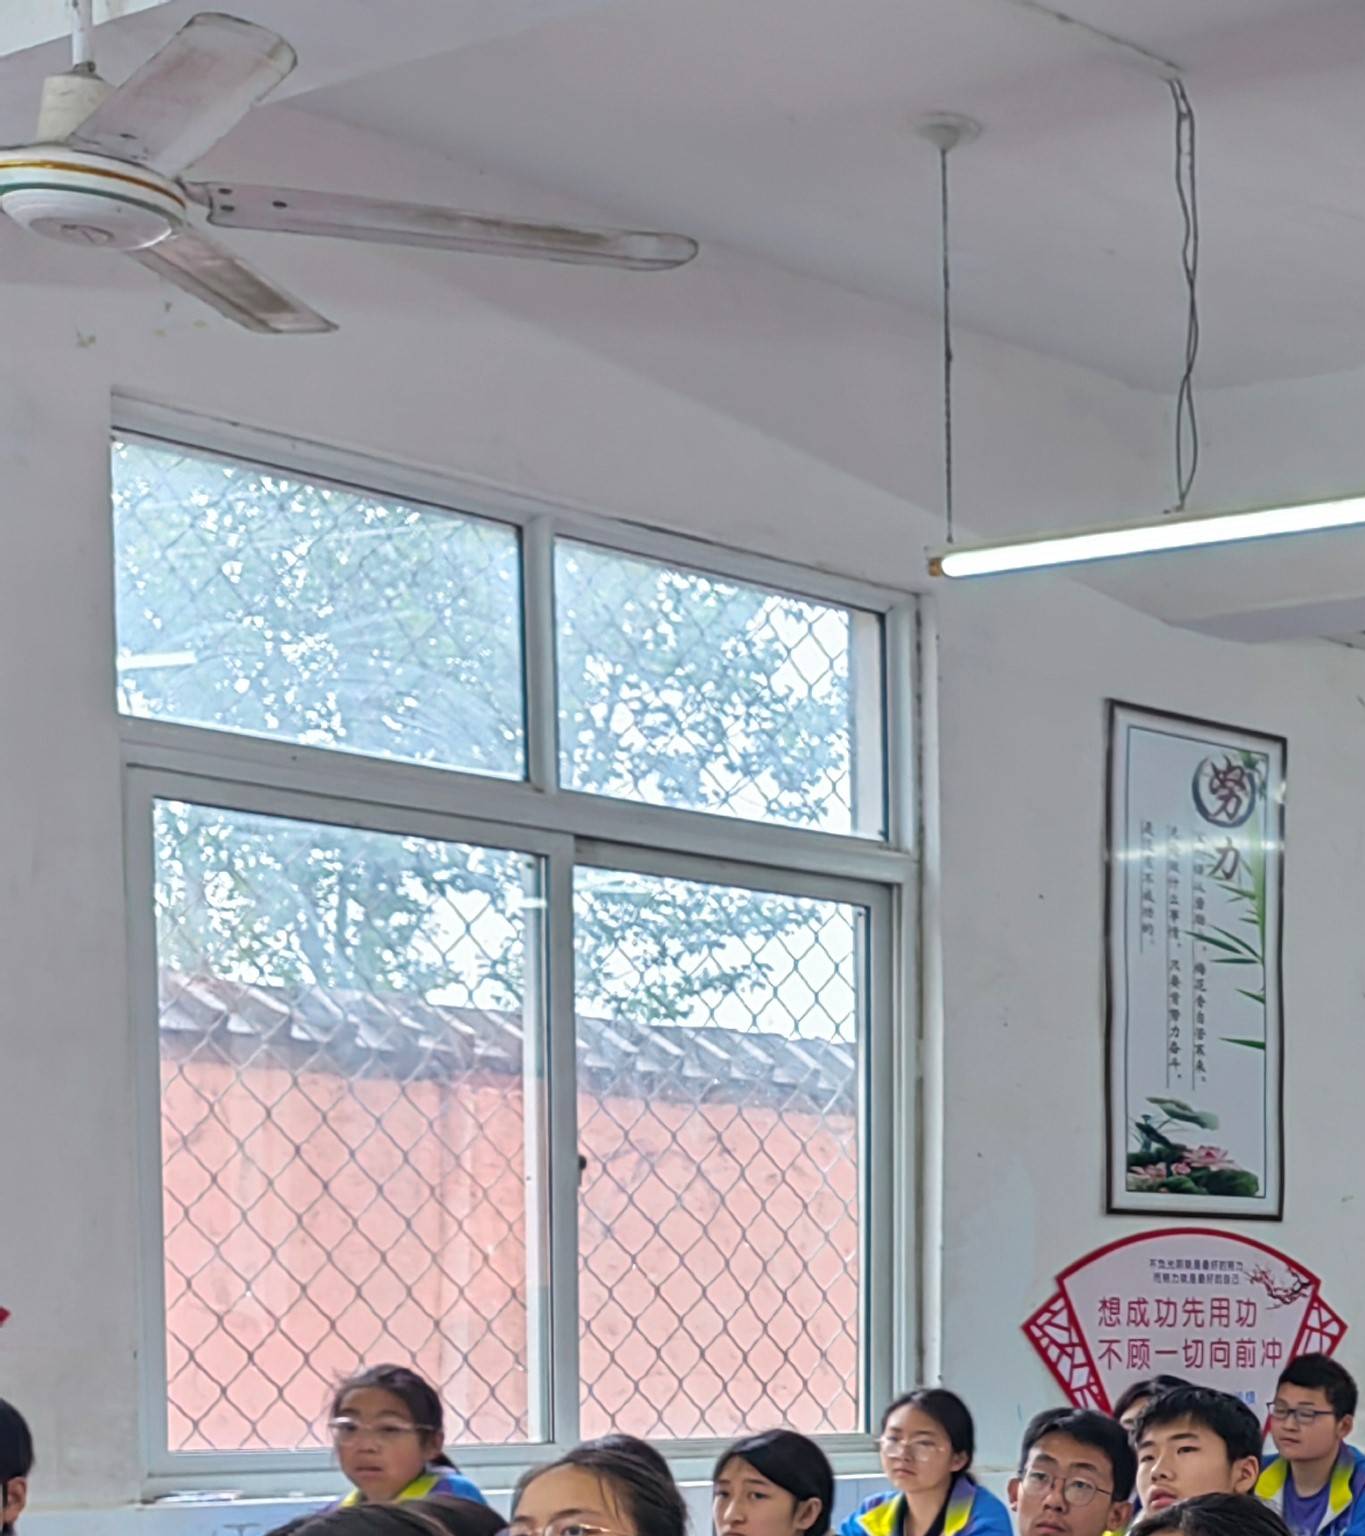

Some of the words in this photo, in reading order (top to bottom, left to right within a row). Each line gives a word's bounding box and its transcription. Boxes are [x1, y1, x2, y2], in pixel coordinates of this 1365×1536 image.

[1097, 1297, 1258, 1329] 想成功先用功
[1097, 1338, 1283, 1371] 不顾一切向前冲
